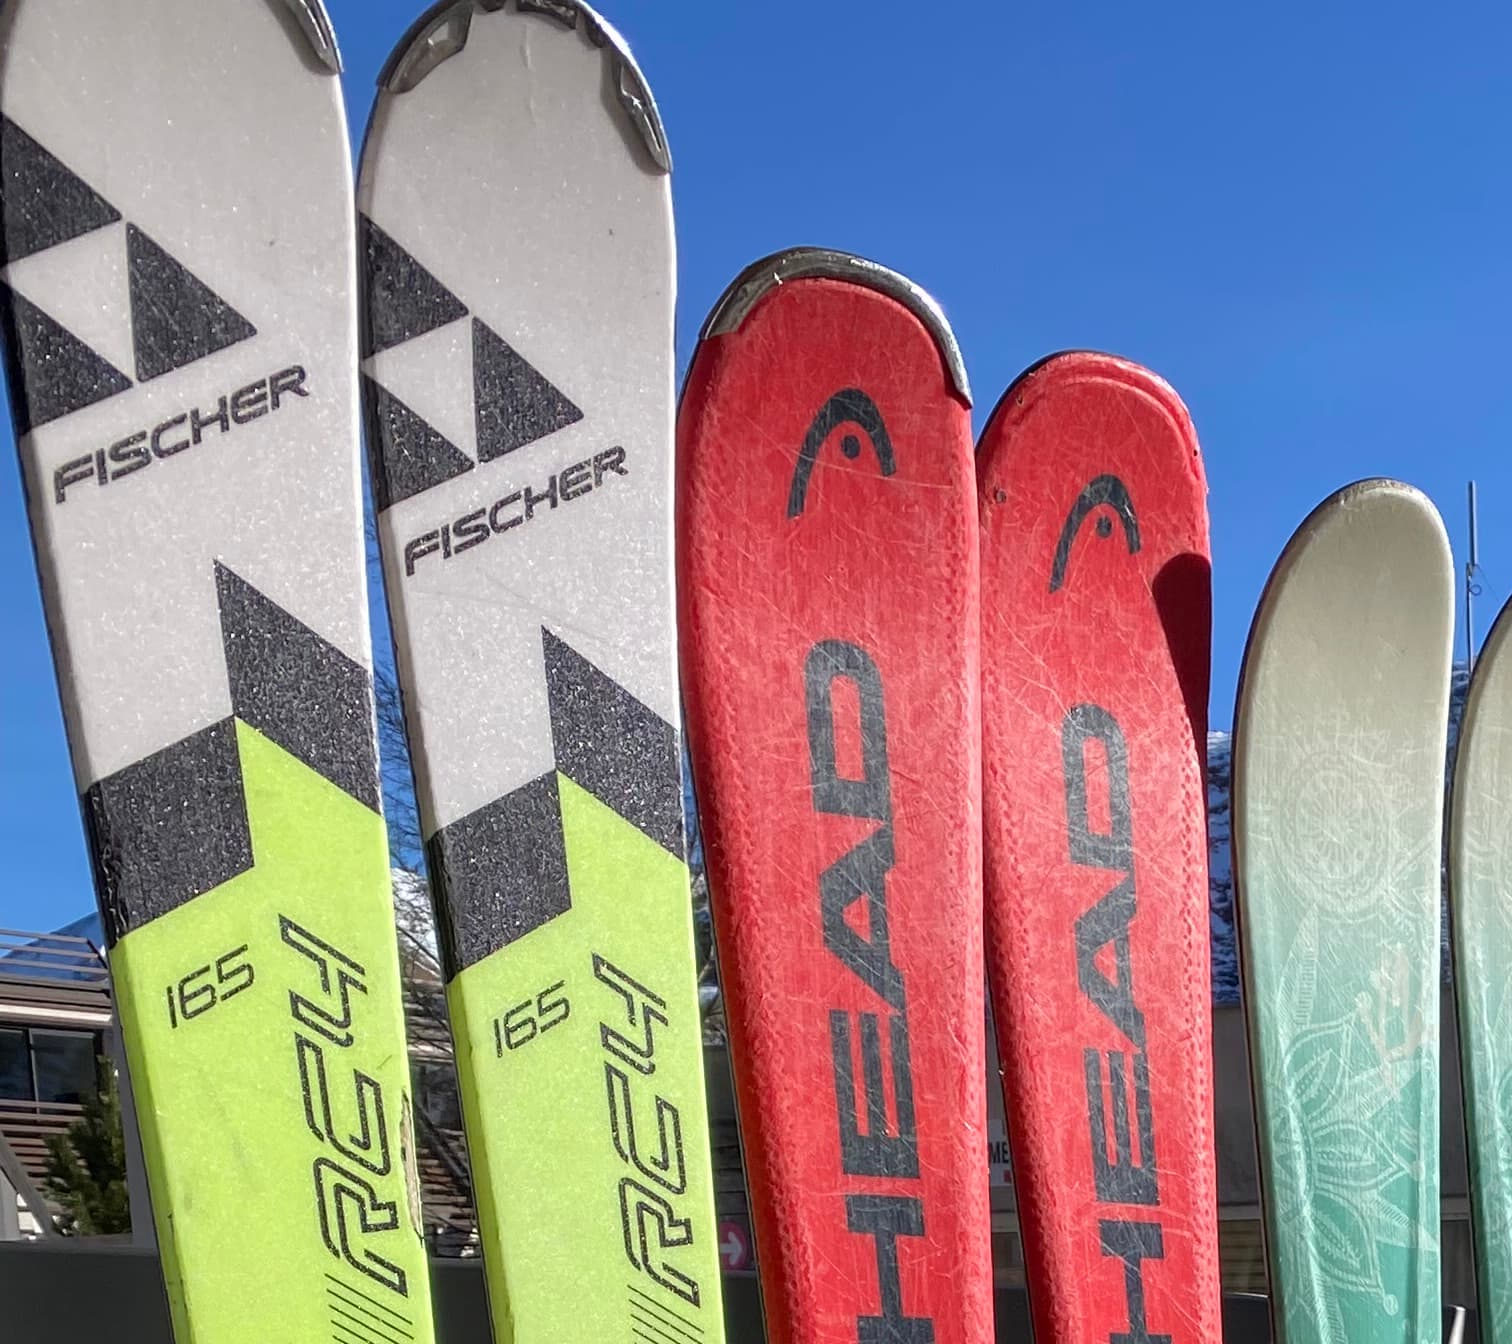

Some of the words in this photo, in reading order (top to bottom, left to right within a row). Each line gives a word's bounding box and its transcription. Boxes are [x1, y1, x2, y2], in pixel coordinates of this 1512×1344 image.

[54, 364, 309, 503] FISCHER
[404, 445, 628, 576] FISCHER
[166, 944, 256, 1029] 165
[494, 980, 571, 1057] 165
[278, 914, 408, 1297] RC4
[591, 952, 700, 1307] RC4
